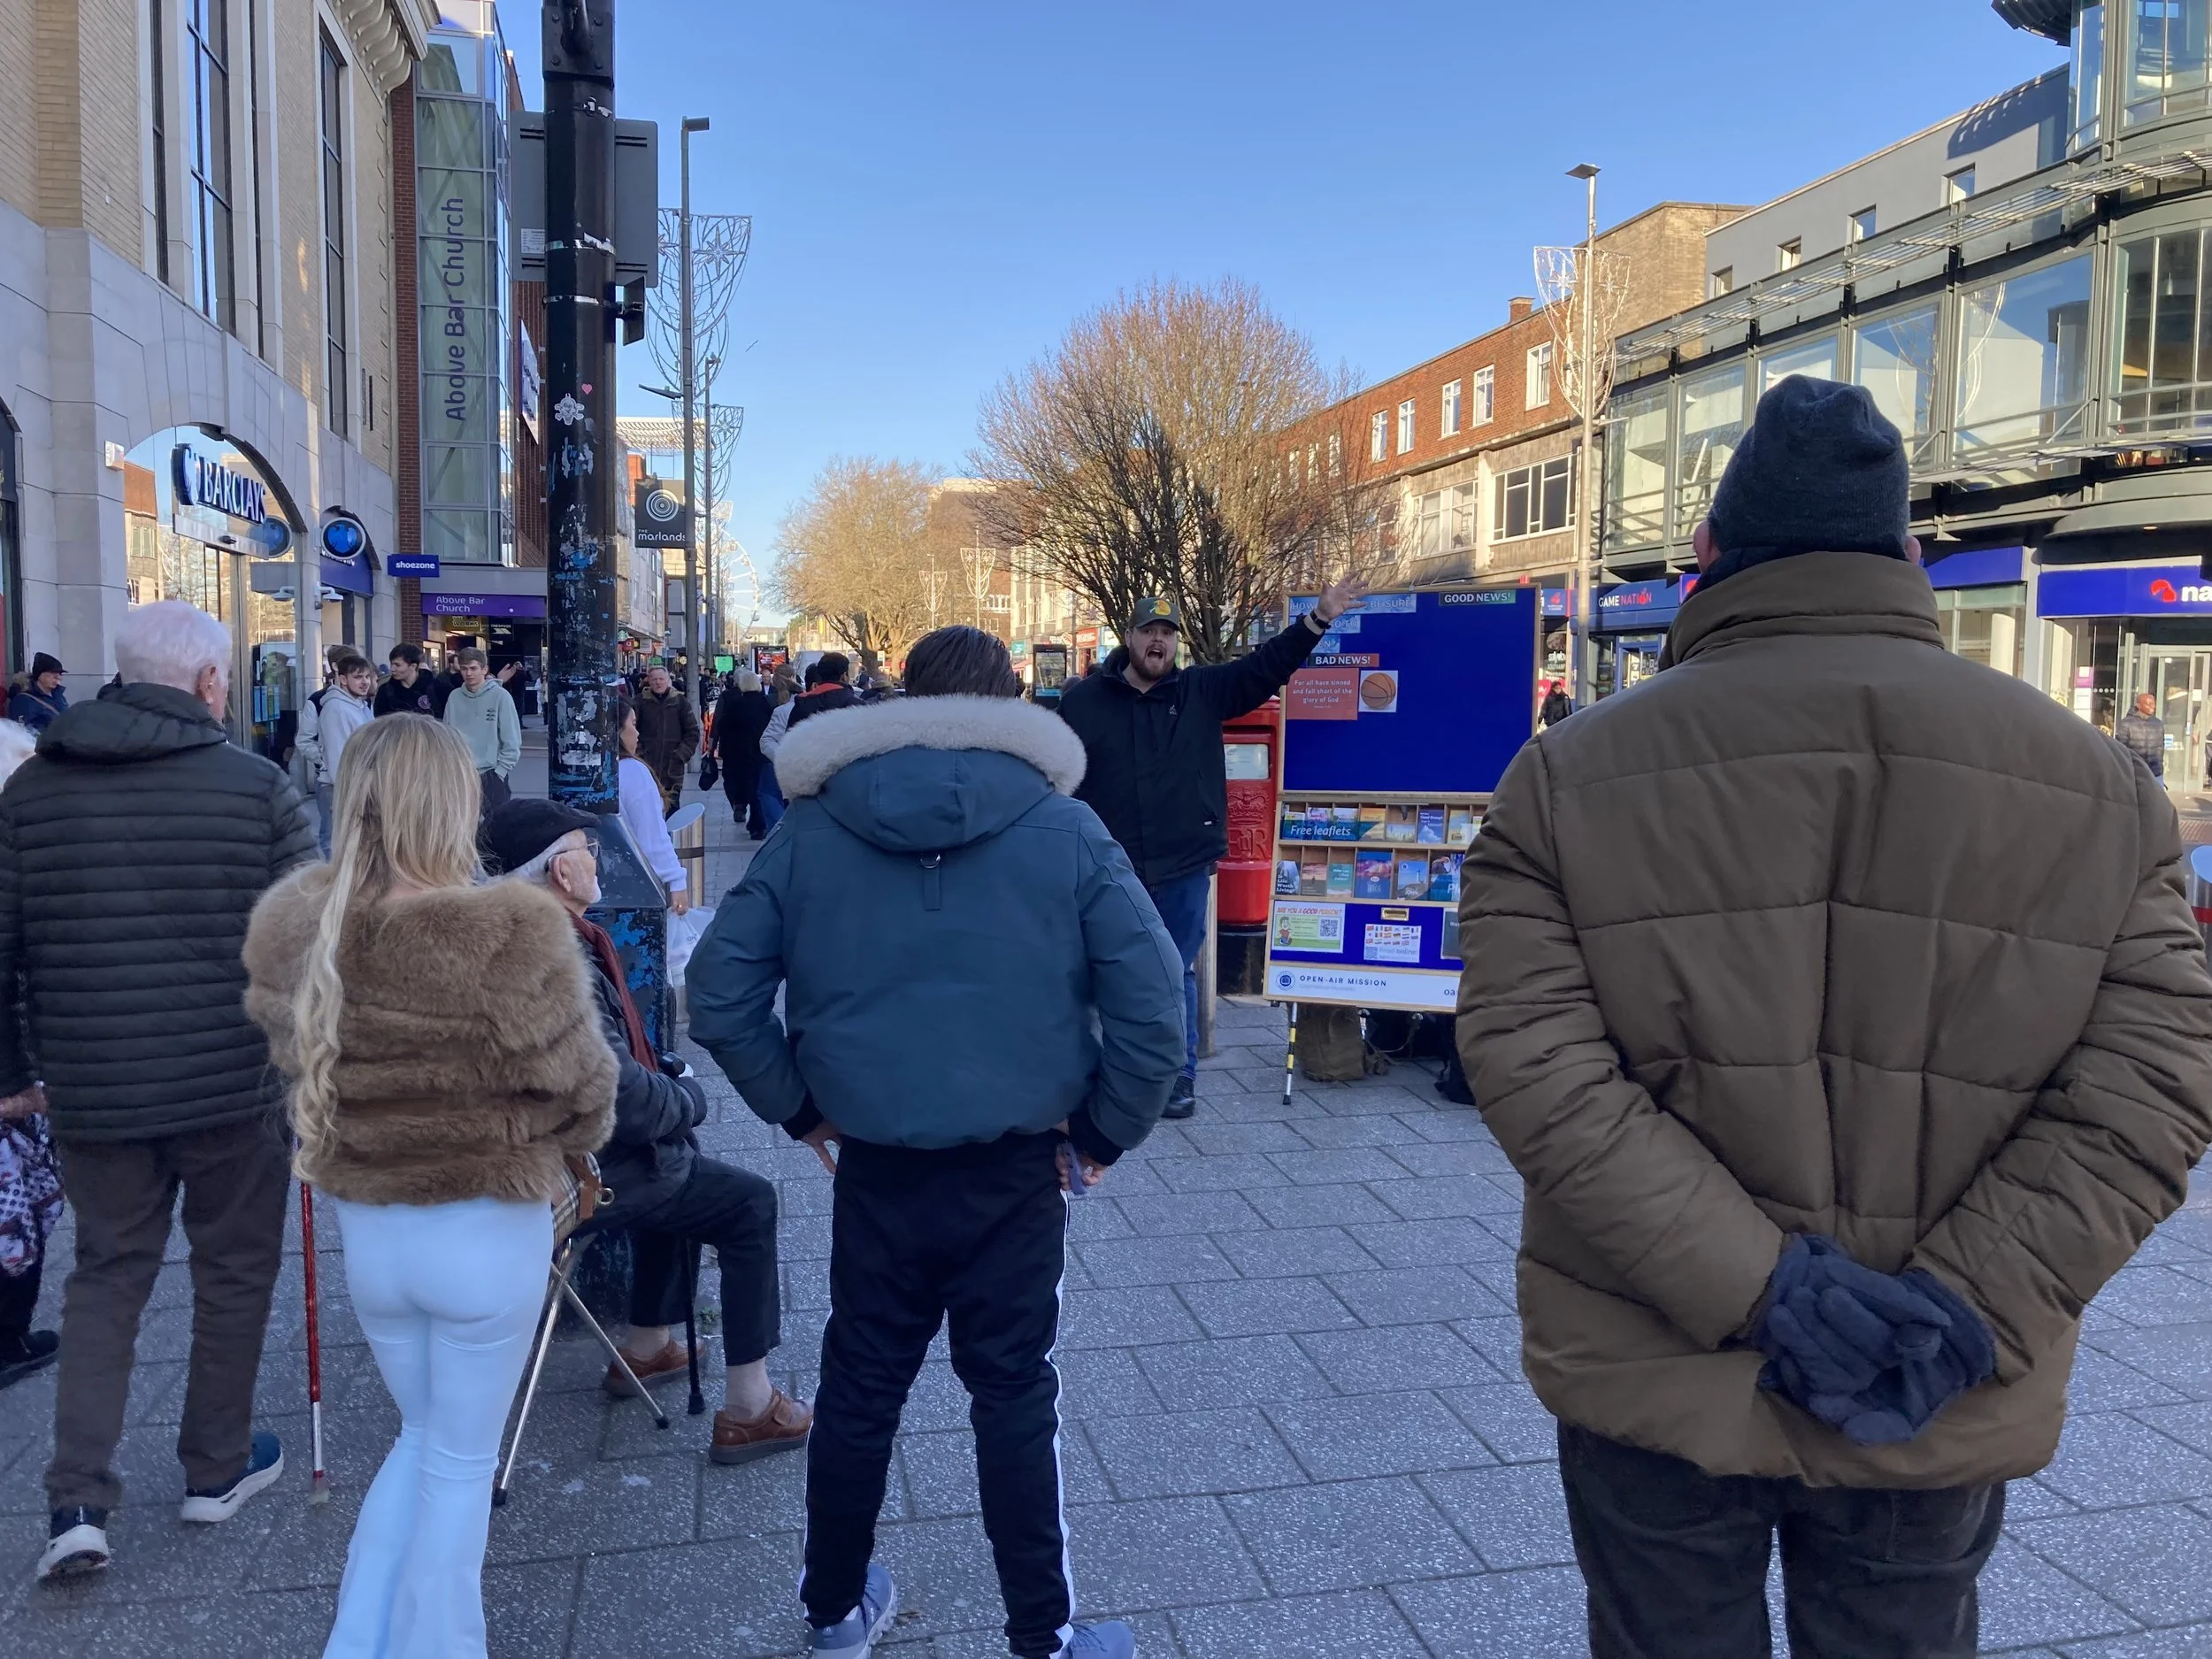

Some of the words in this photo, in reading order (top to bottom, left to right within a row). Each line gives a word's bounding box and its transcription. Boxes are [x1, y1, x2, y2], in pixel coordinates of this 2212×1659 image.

[441, 197, 465, 287] Church
[444, 294, 465, 337] Bar
[444, 344, 467, 421] Above
[204, 462, 266, 525] BARCLAYS
[396, 561, 435, 570] shoezone
[435, 595, 466, 604] Above
[468, 596, 486, 605] Bar
[1444, 594, 1475, 603] GOOD
[1476, 592, 1510, 602] NEWS!
[1598, 595, 1620, 608] GAME
[435, 603, 471, 613] Church
[1315, 656, 1336, 664] BAD
[1338, 656, 1371, 664] NEWS!
[1290, 825, 1312, 835] Free
[1313, 826, 1351, 837] leaflets
[1300, 975, 1344, 984] OPEN-AIR
[1348, 978, 1387, 987] MISSION
